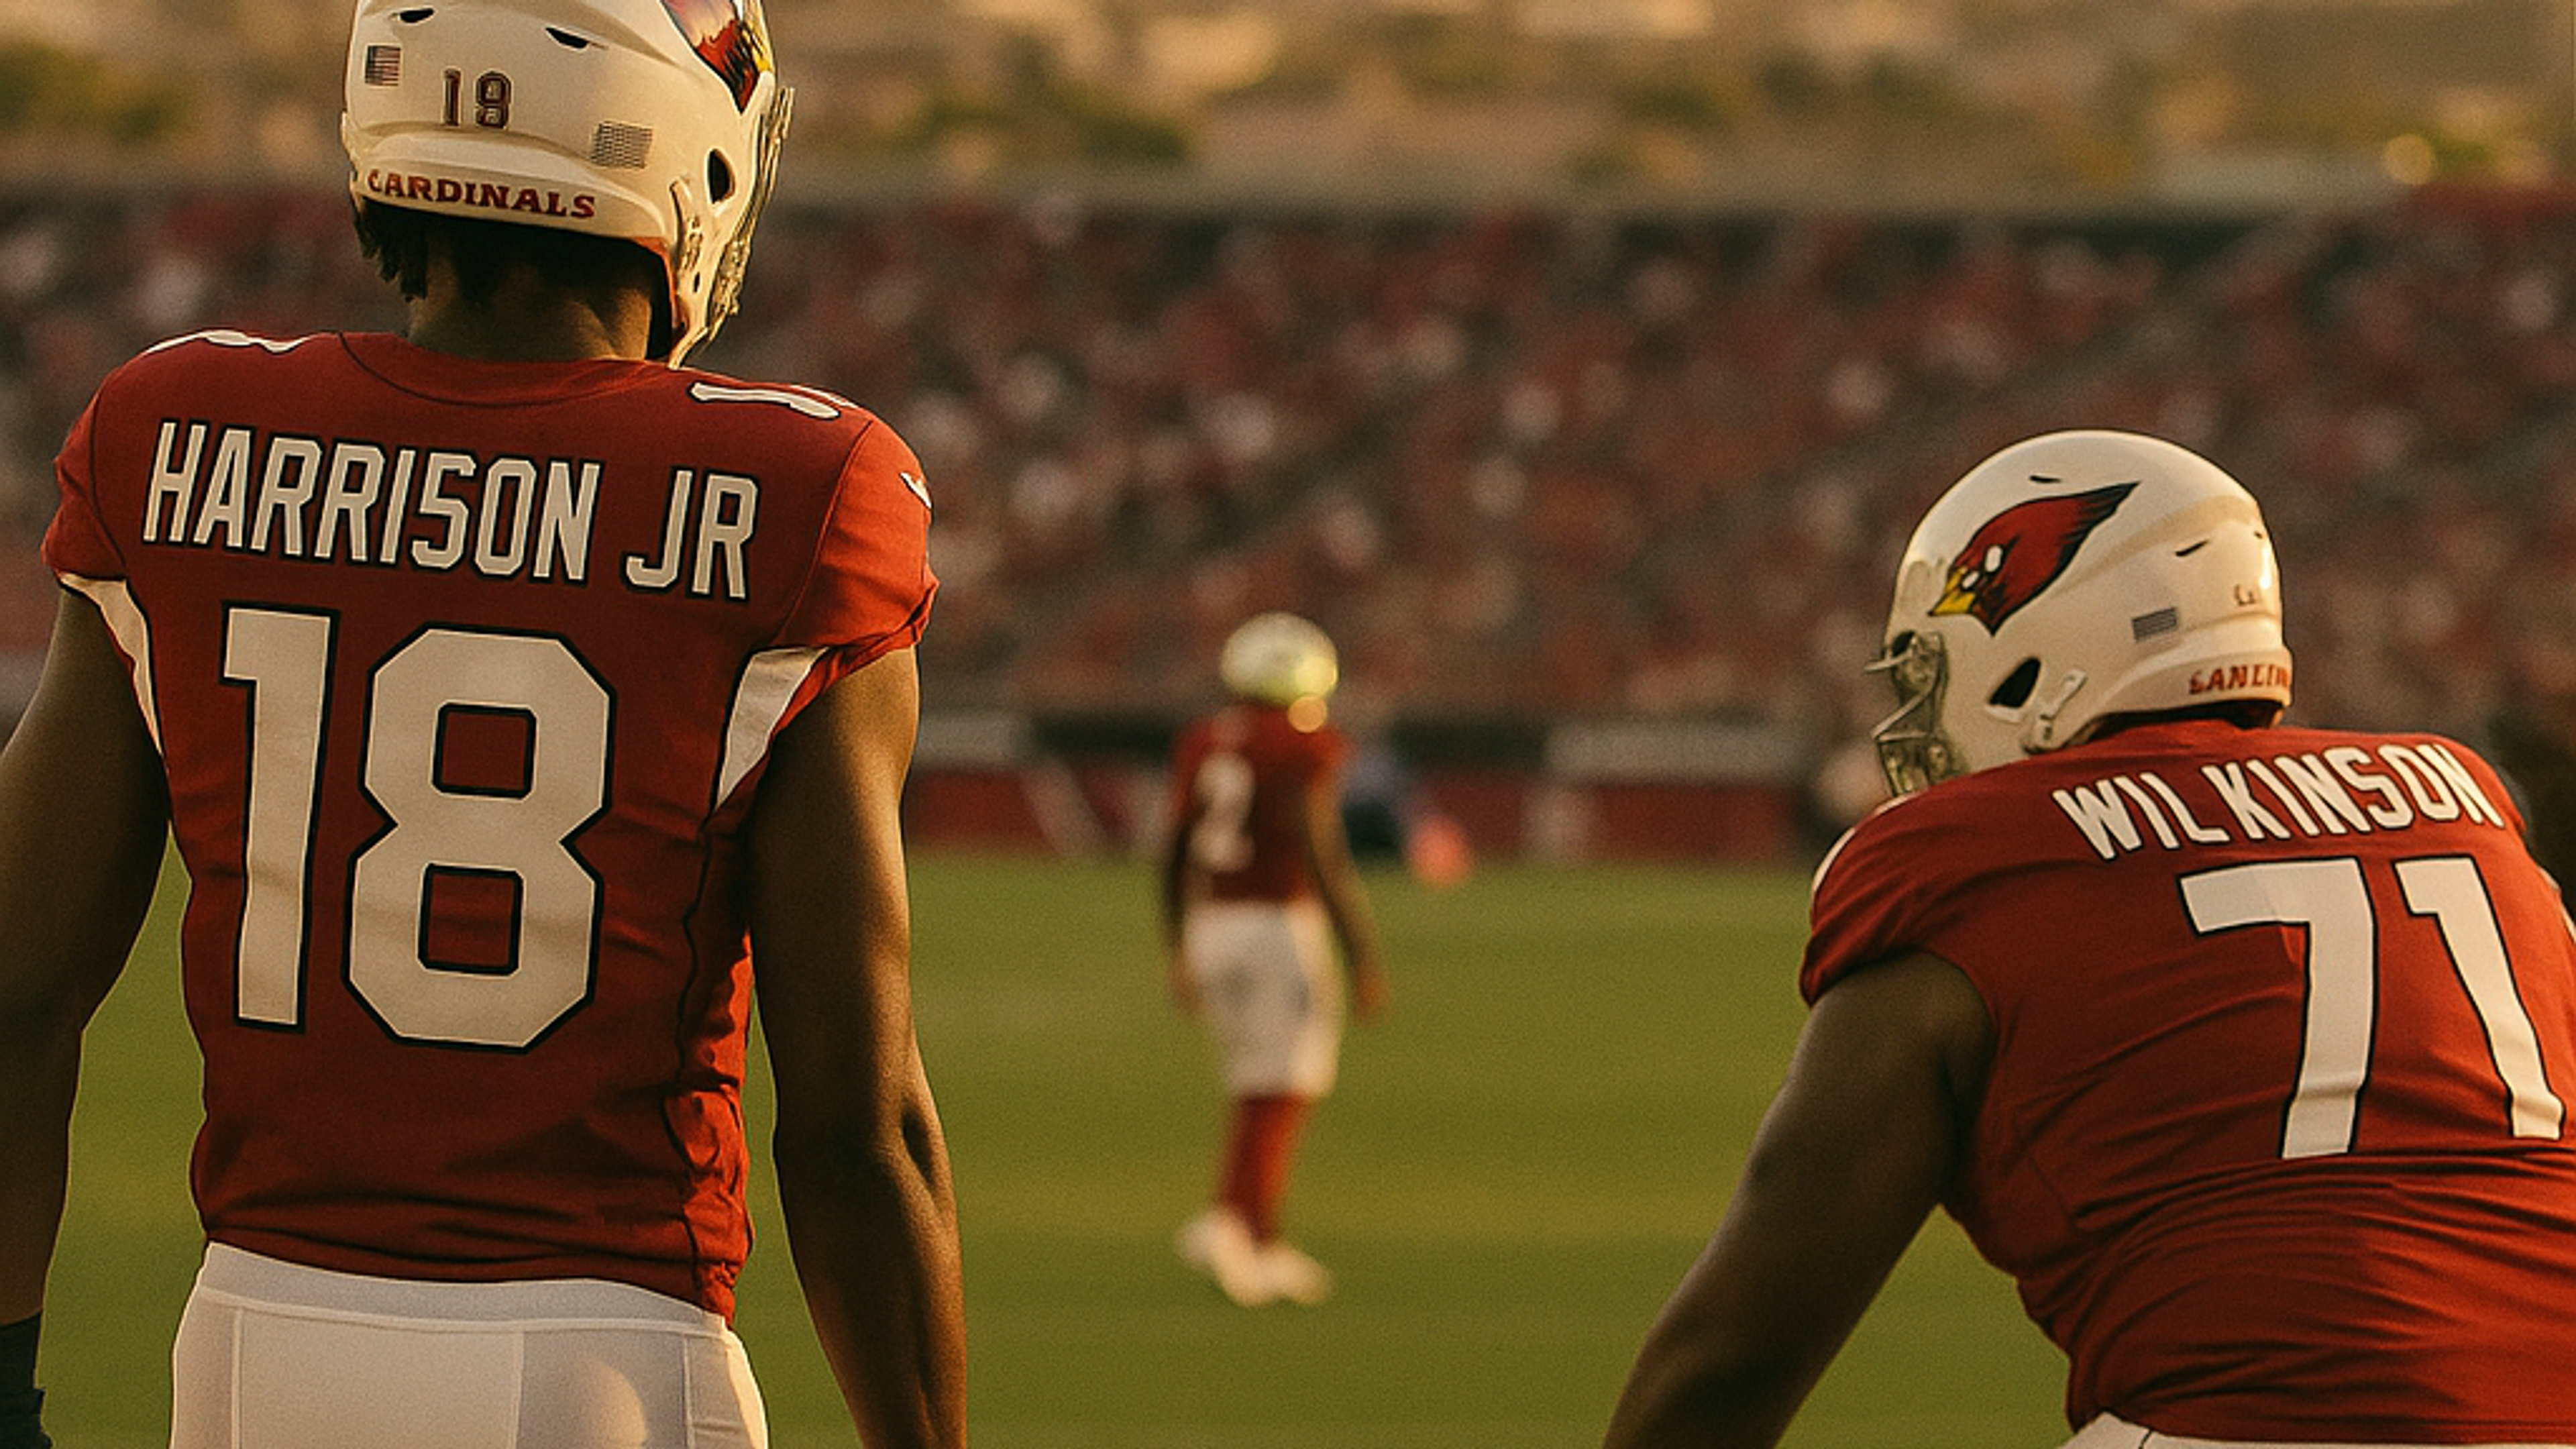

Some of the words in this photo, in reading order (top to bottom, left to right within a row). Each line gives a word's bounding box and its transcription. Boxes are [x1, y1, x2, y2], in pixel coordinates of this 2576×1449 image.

[368, 169, 595, 219] CARDINALS
[141, 420, 601, 582] HARRISON
[623, 468, 759, 601] JR
[220, 602, 616, 1053] 18
[2053, 743, 2505, 861] WILKINSON
[2179, 855, 2566, 1159] 71
